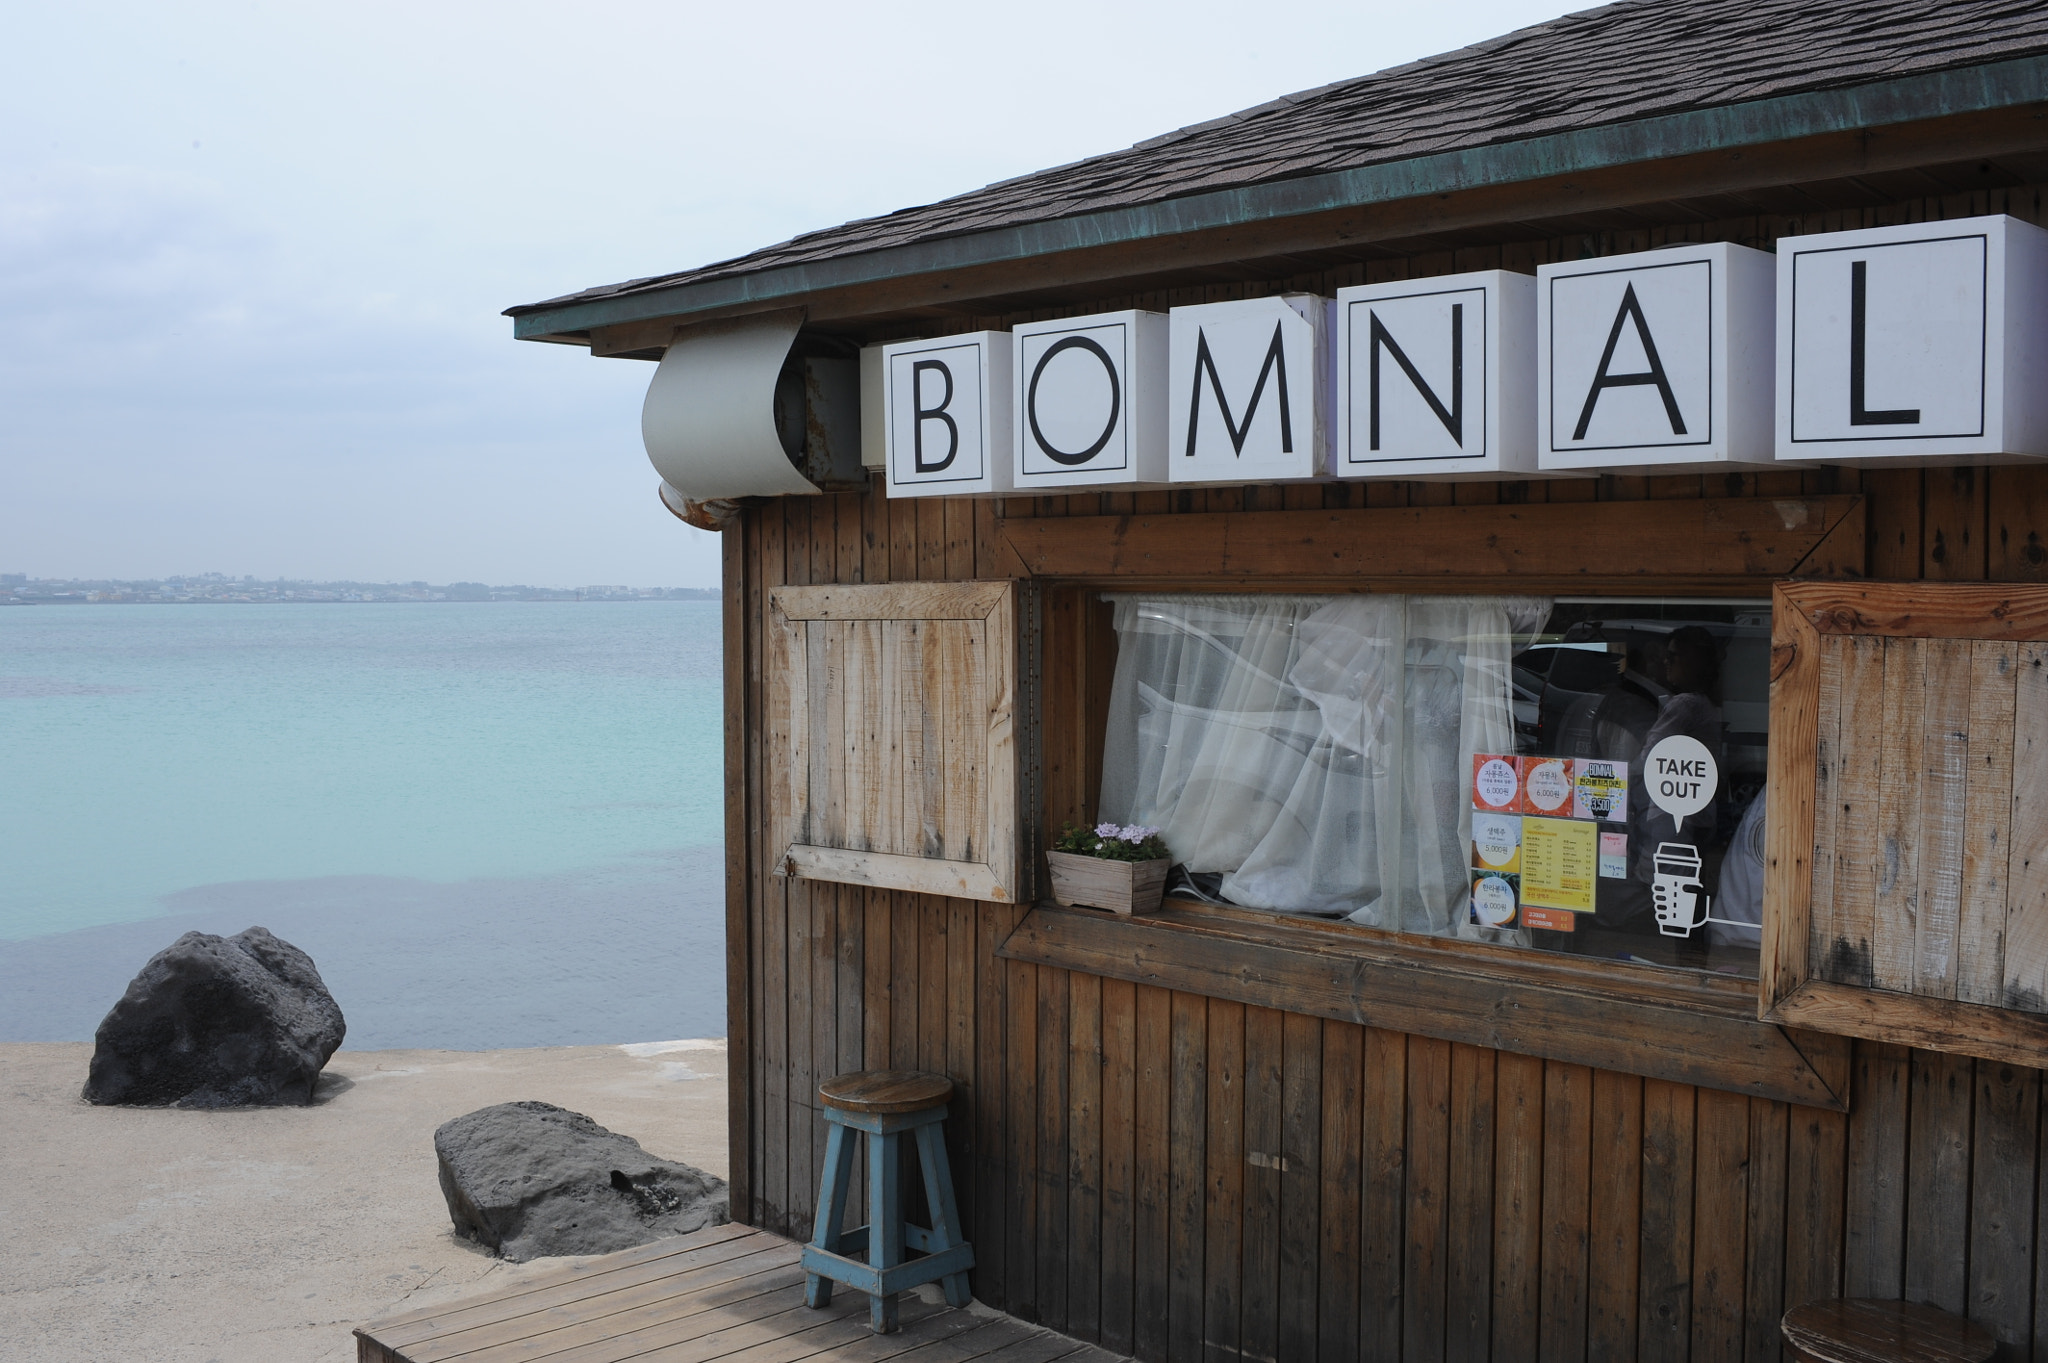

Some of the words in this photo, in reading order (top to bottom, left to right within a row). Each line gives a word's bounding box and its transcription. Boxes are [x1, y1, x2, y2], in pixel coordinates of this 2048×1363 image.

[913, 261, 1920, 473] BOMNAL
[1589, 763, 1614, 778] BOMNAL
[1656, 757, 1706, 778] TAKE
[1660, 780, 1701, 799] OUT
